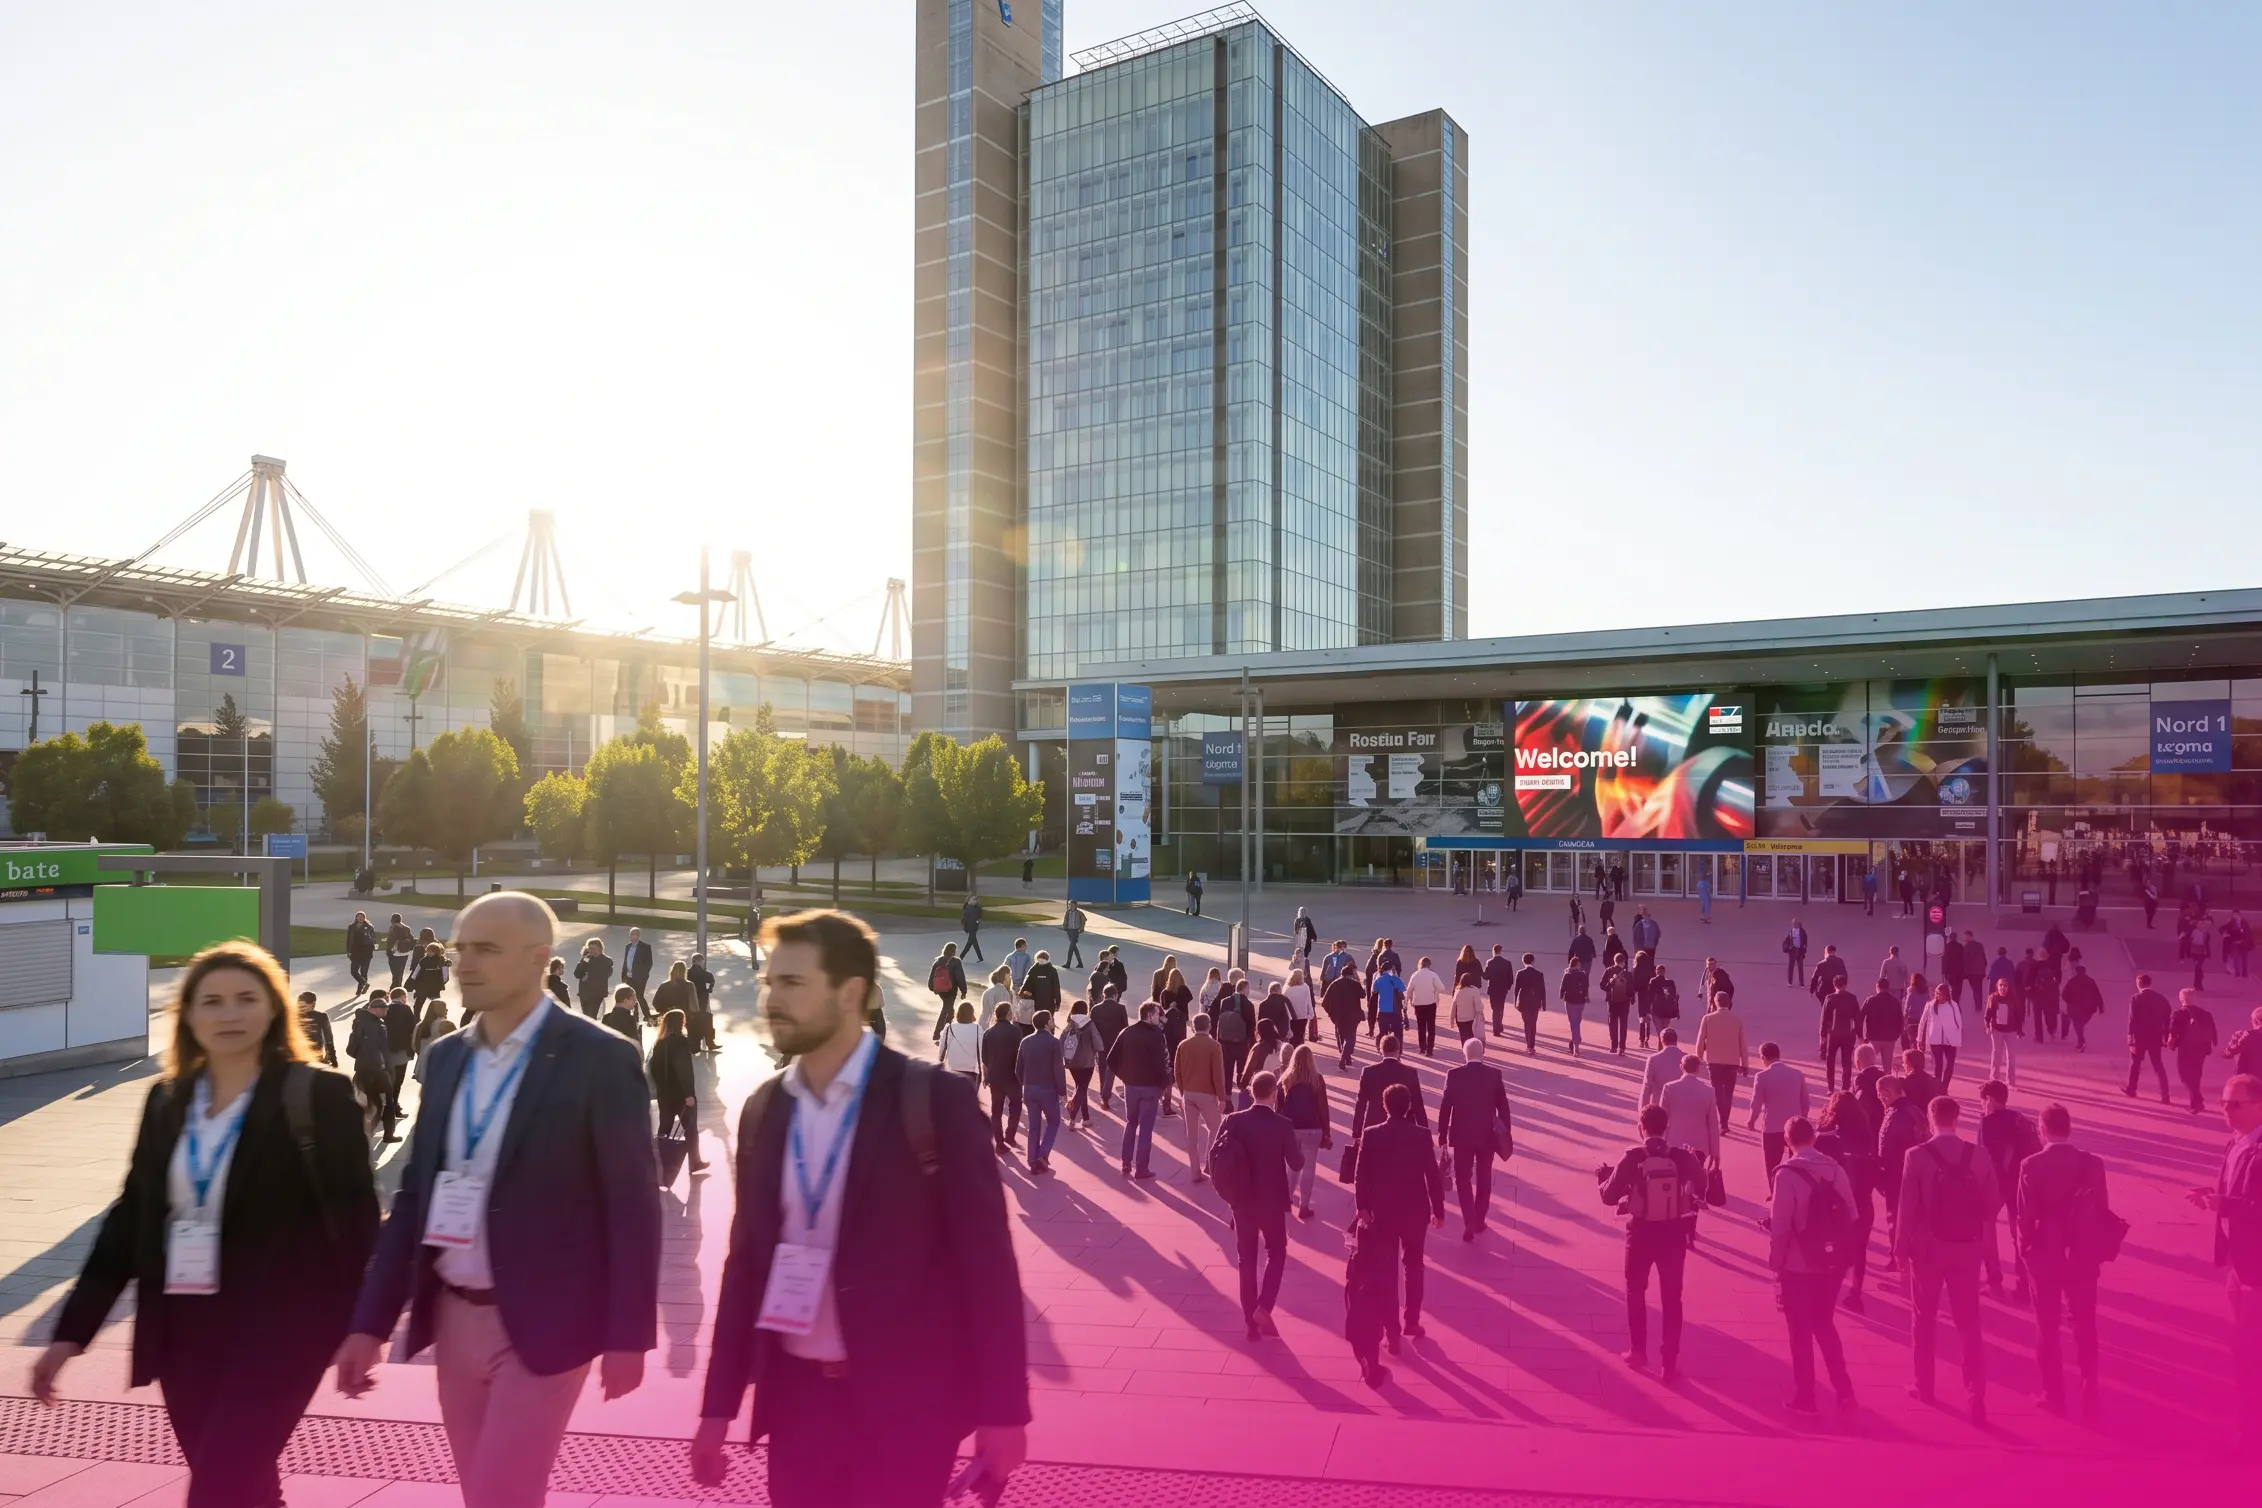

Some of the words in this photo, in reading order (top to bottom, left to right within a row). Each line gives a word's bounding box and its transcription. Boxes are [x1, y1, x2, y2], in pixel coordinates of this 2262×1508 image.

[221, 648, 235, 670] 2
[2156, 715, 2209, 733] Nord
[2216, 715, 2226, 732] 1
[1205, 742, 1234, 754] Nord
[1514, 746, 1637, 769] Welcome!
[6, 860, 60, 881] bate
